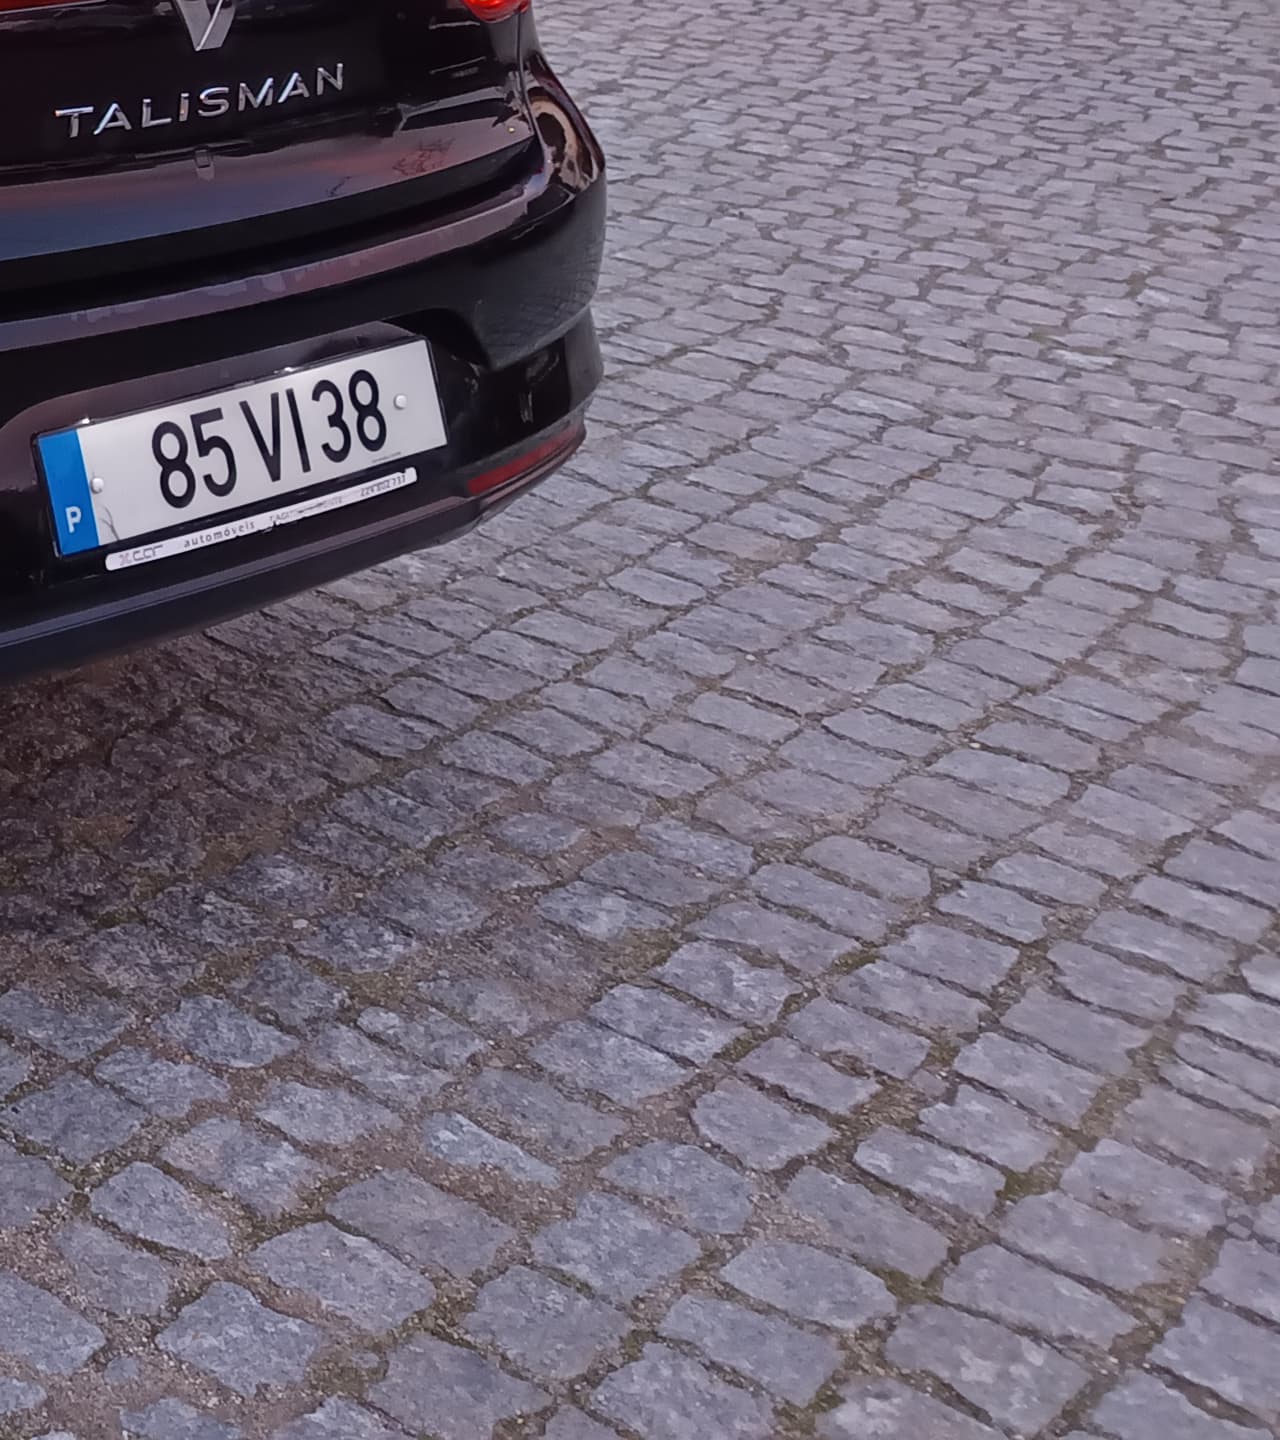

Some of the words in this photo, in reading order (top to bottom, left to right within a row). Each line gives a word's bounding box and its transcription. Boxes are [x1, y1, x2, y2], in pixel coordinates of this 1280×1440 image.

[54, 62, 344, 139] TALISMAN
[64, 505, 82, 534] P
[183, 520, 256, 549] automóveis
